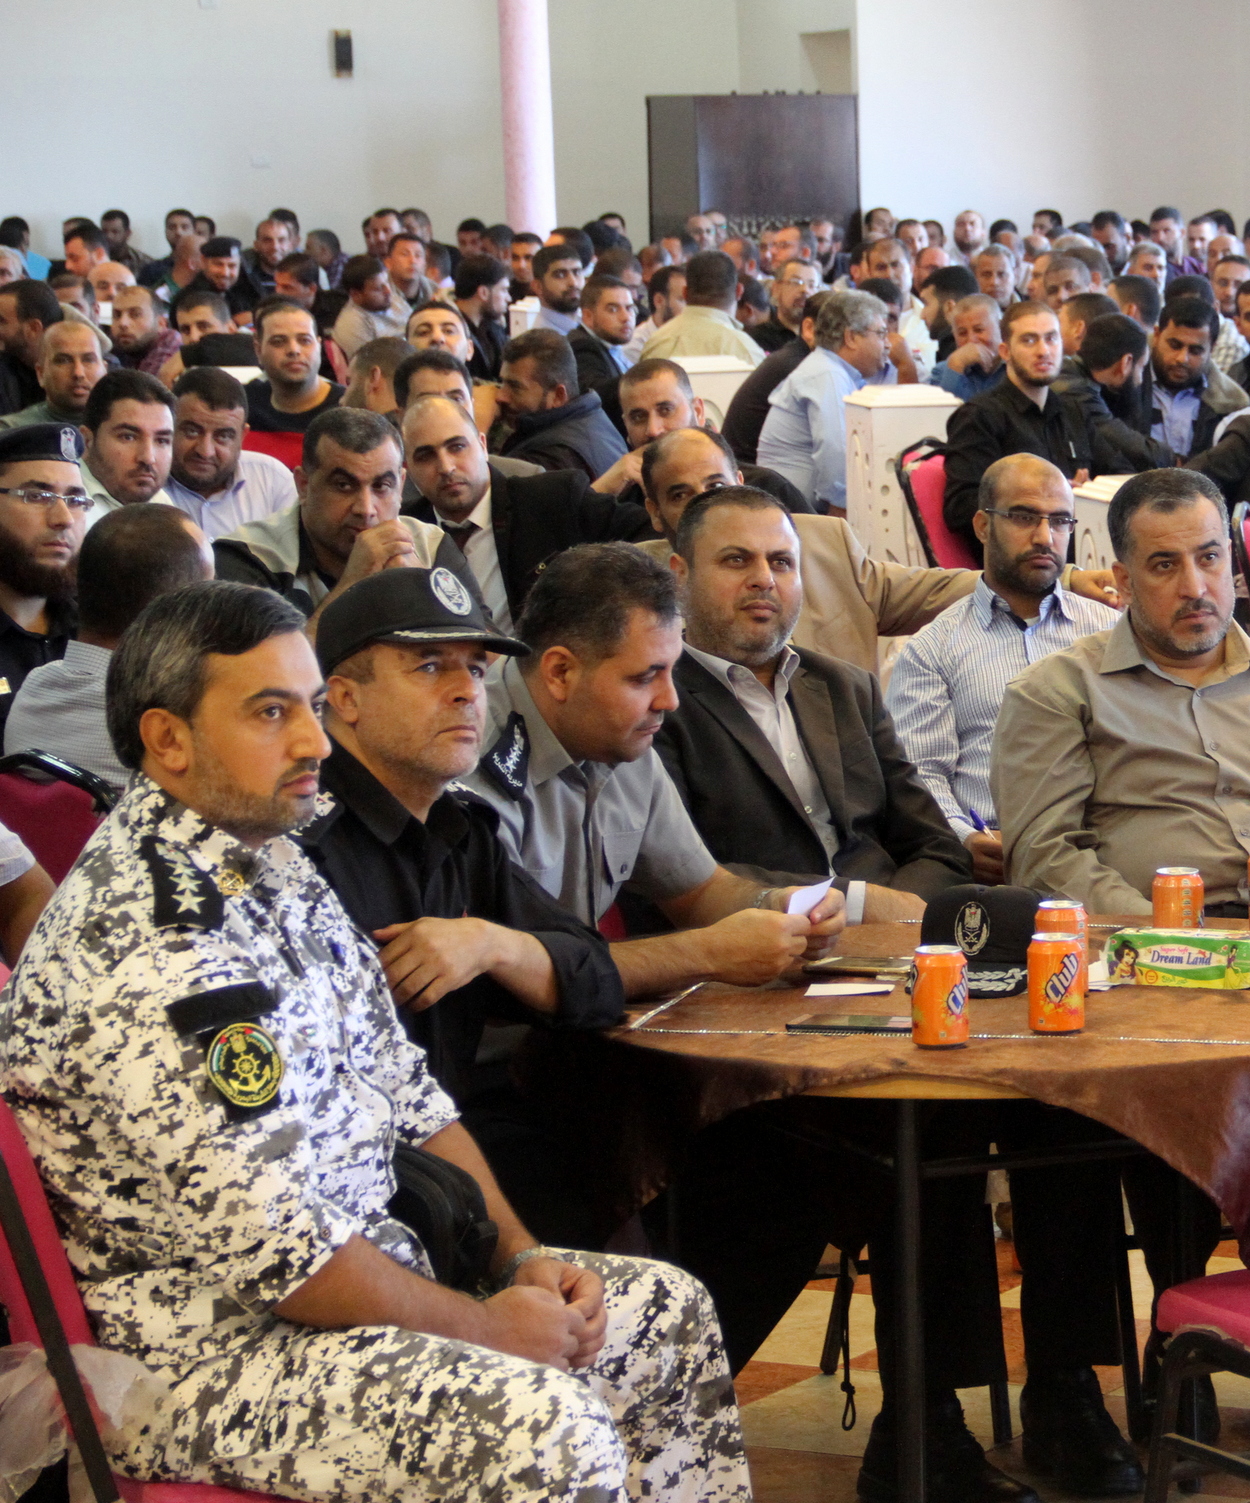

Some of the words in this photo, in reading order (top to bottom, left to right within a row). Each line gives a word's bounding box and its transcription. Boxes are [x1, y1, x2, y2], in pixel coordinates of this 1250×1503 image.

[1150, 950, 1184, 964] Dream
[1186, 952, 1213, 966] Land
[1045, 953, 1079, 1004] Club
